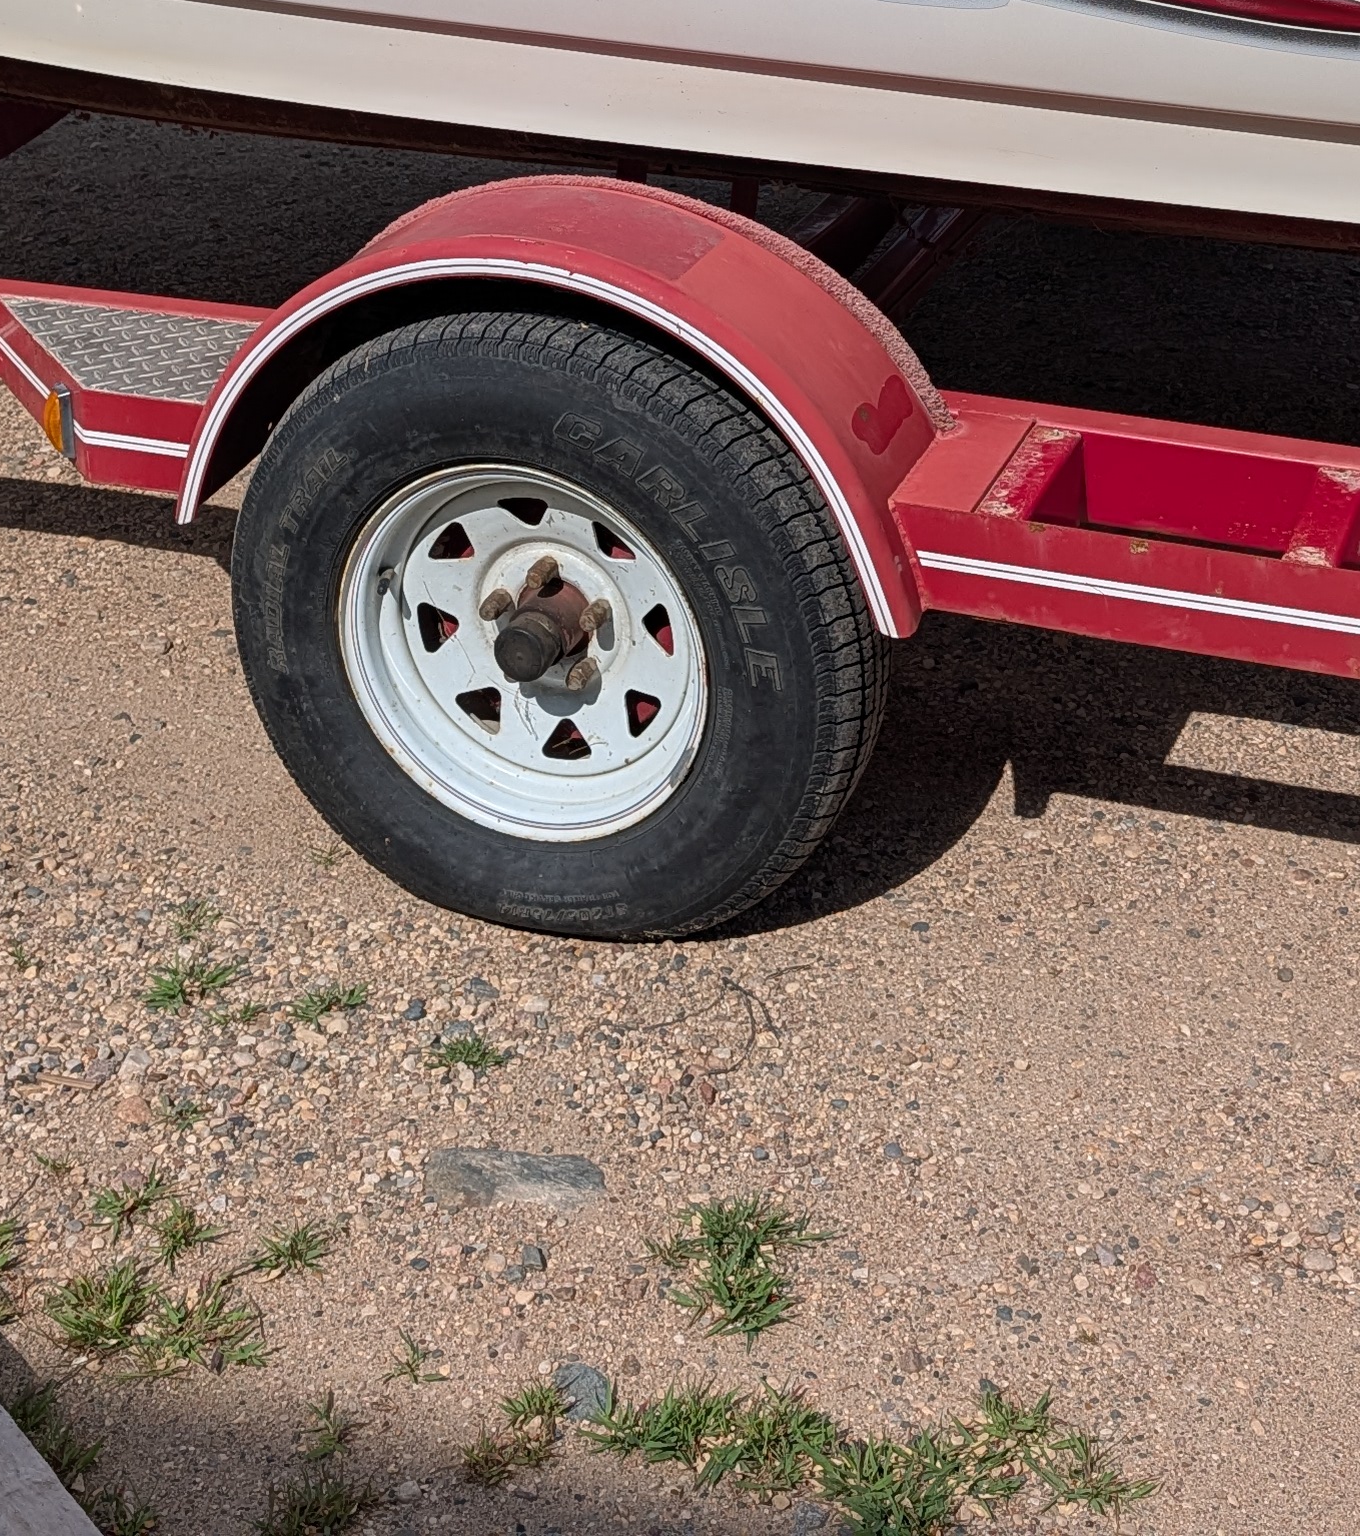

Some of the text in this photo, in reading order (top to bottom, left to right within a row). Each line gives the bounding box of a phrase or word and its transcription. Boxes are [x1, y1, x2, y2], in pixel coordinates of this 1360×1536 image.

[262, 446, 349, 676] RADIAL TRAIL
[552, 412, 783, 693] CARLISLE
